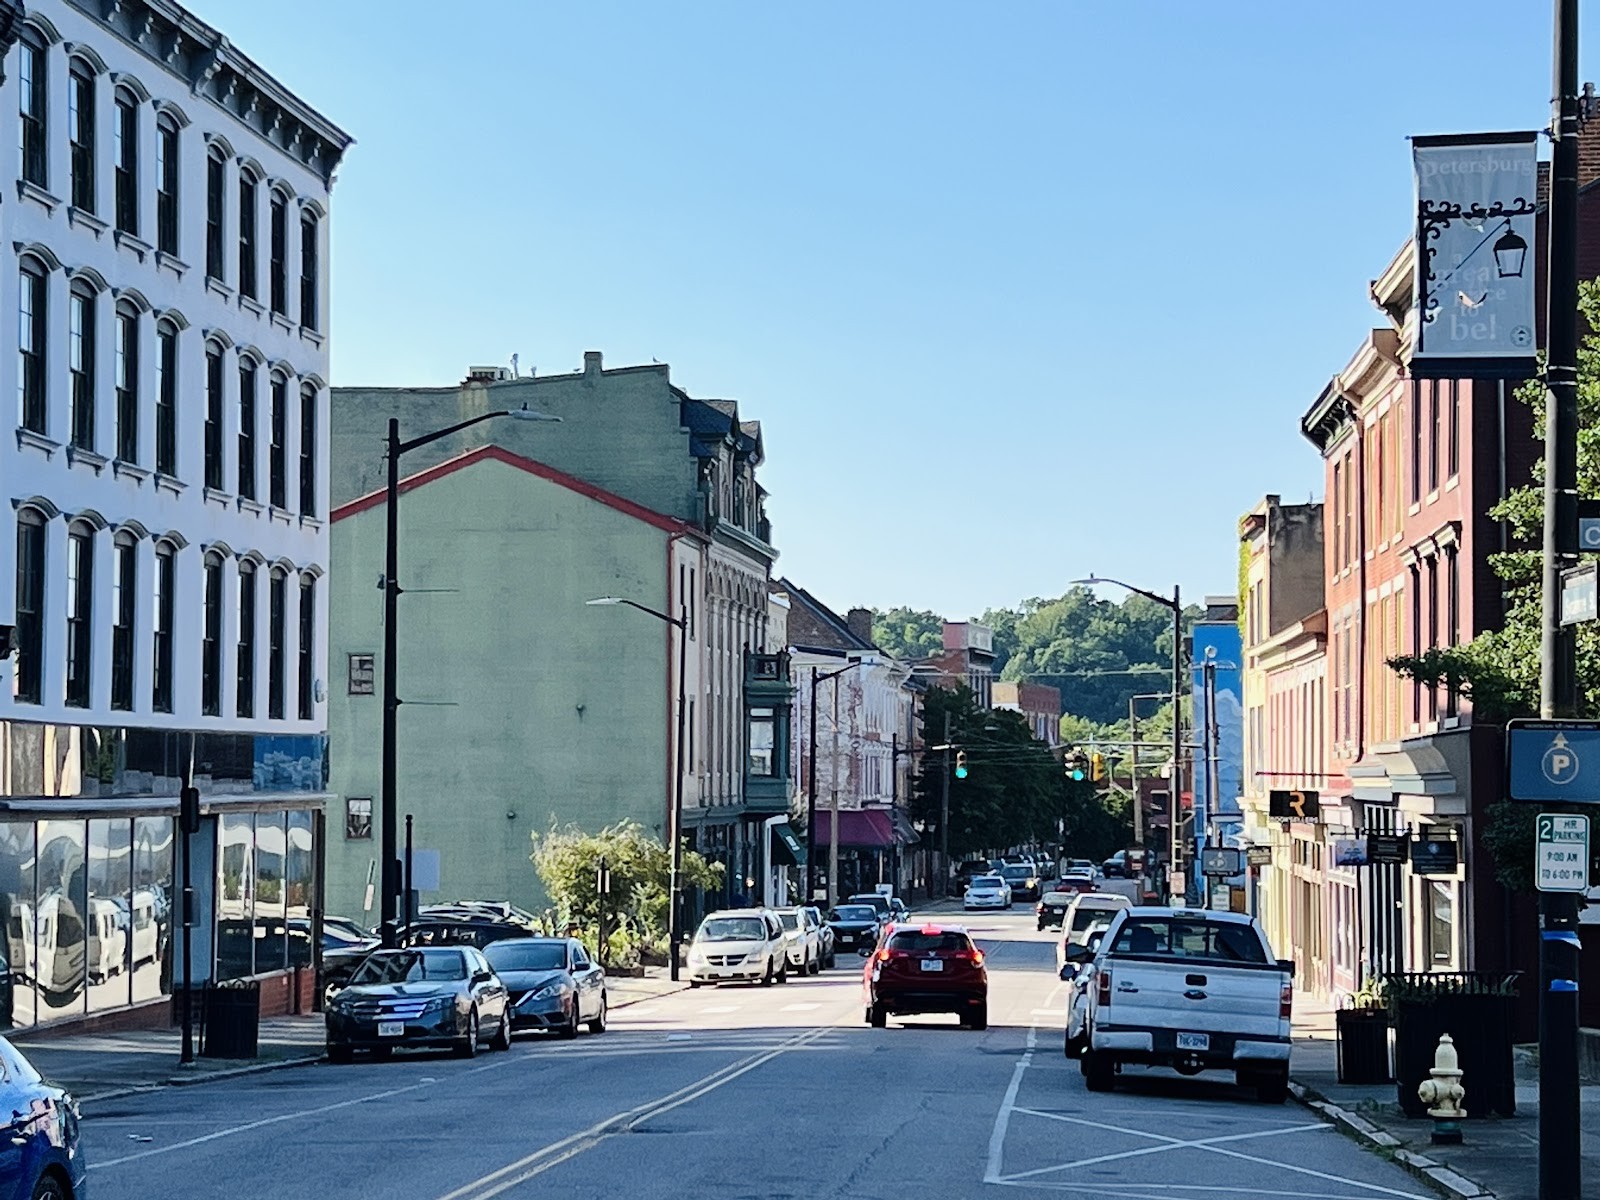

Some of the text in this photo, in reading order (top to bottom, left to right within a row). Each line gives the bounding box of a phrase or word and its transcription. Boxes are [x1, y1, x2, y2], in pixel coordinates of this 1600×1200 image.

[1451, 314, 1496, 341] be!
[1552, 754, 1570, 775] P
[1540, 819, 1577, 839] 2 HR
[1554, 830, 1586, 840] PARKING
[1567, 852, 1578, 862] AM
[1573, 870, 1583, 880] PM
